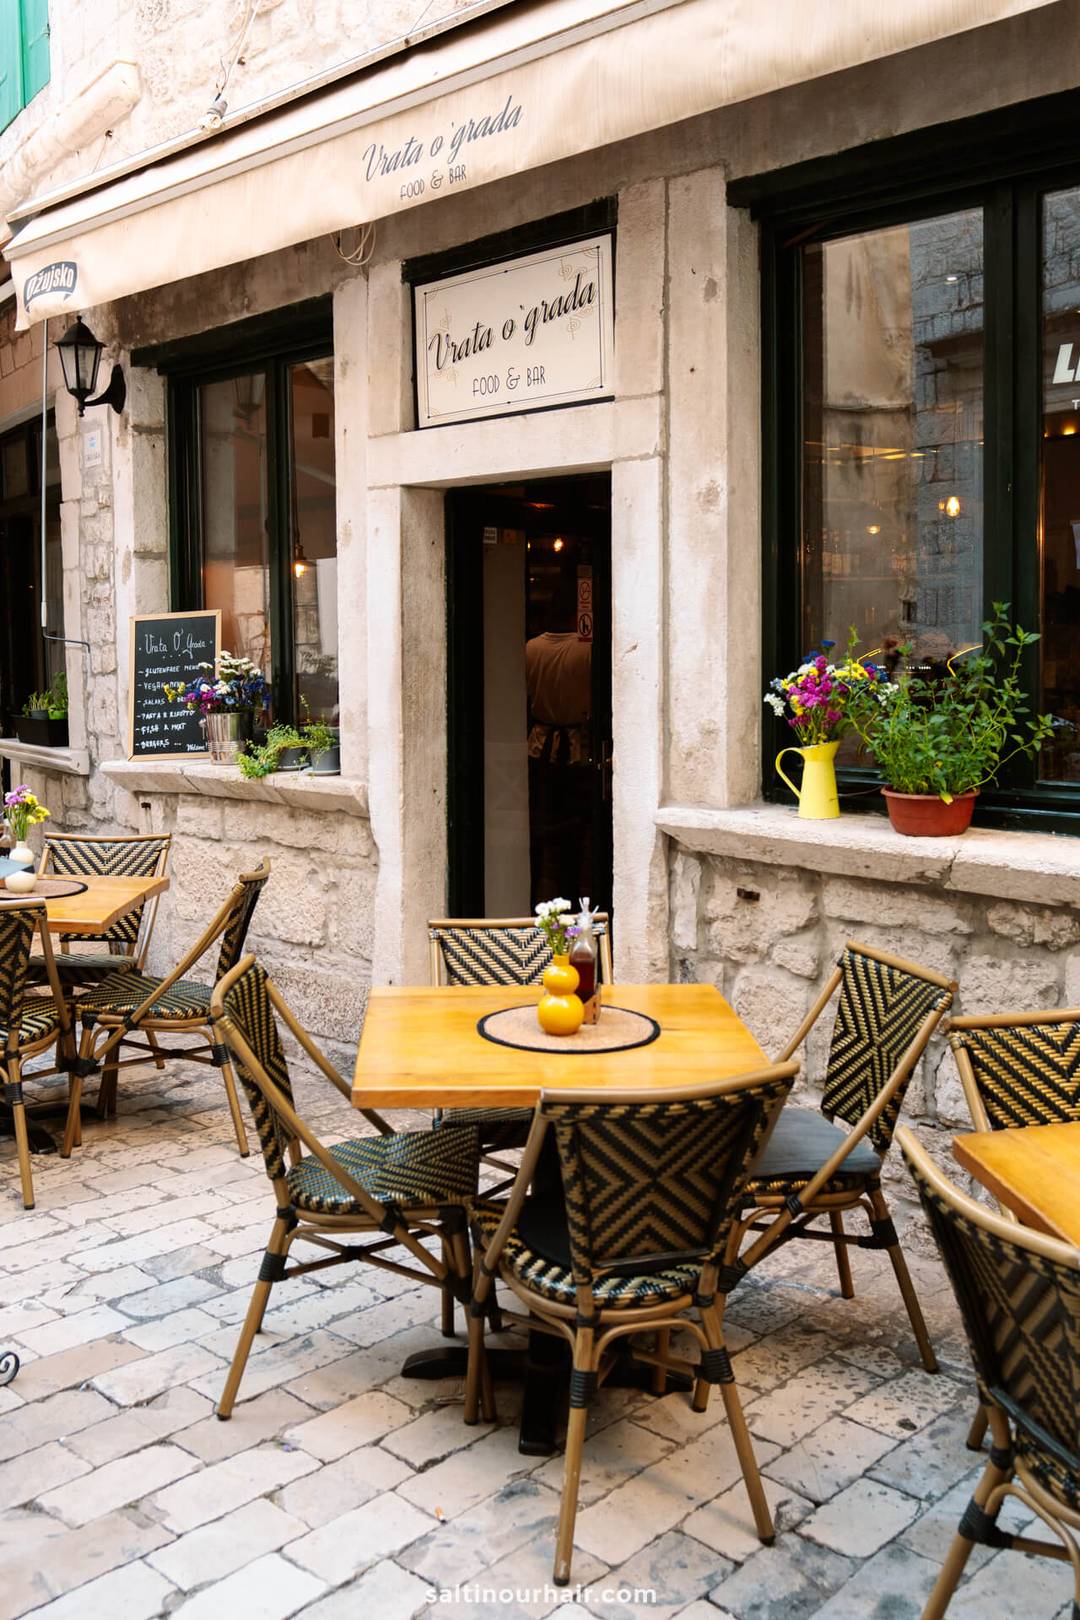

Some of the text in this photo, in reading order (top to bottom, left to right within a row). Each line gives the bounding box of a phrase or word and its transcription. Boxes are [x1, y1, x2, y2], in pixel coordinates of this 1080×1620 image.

[362, 135, 424, 182] Vrata
[400, 165, 467, 200] FOOD & BAR
[26, 263, 75, 301] Ožujsko
[428, 321, 494, 370] Vrata
[1052, 343, 1080, 384] L
[472, 365, 546, 397] FOOD & BAR
